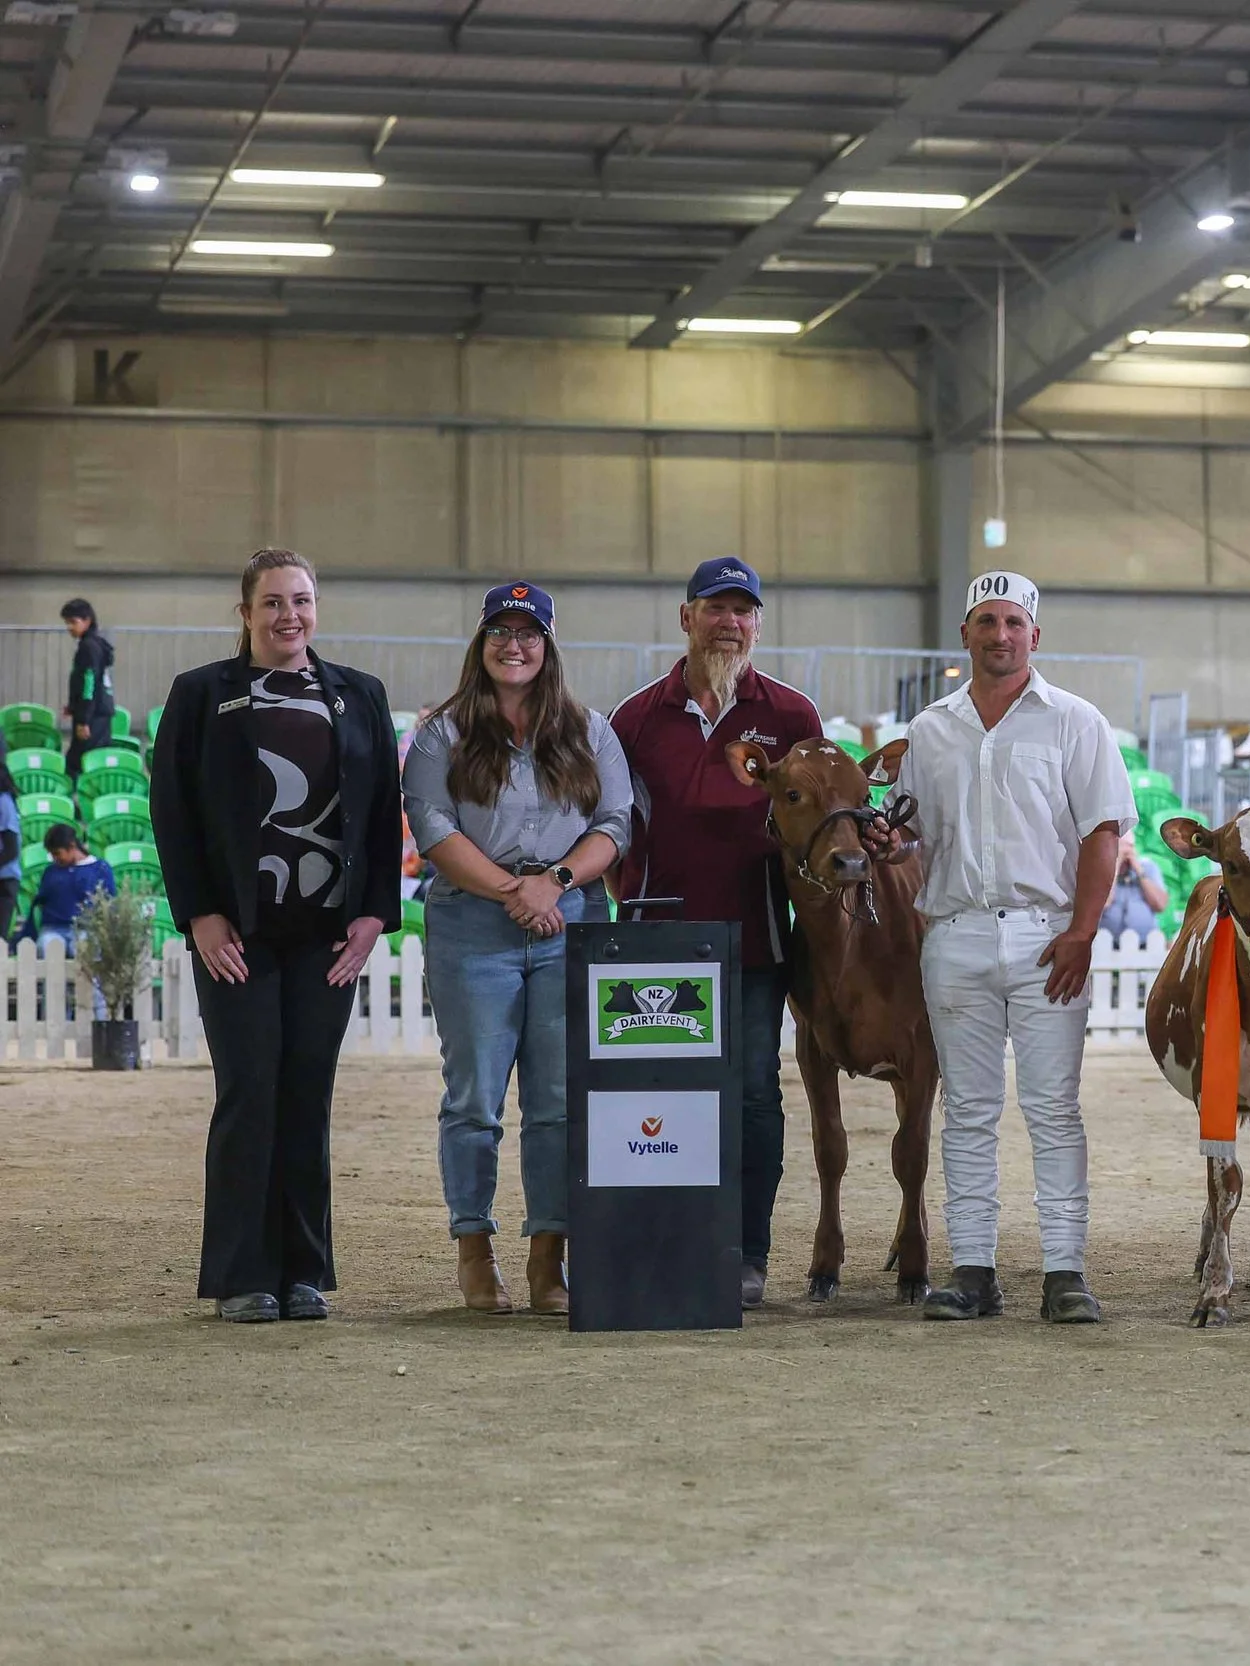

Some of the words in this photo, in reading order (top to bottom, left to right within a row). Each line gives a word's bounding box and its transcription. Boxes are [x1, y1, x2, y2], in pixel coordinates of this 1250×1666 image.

[93, 349, 142, 404] K
[972, 575, 1009, 604] 190
[502, 599, 536, 612] Vytelle
[647, 989, 664, 1000] NZ
[628, 1141, 679, 1156] Vytelle
